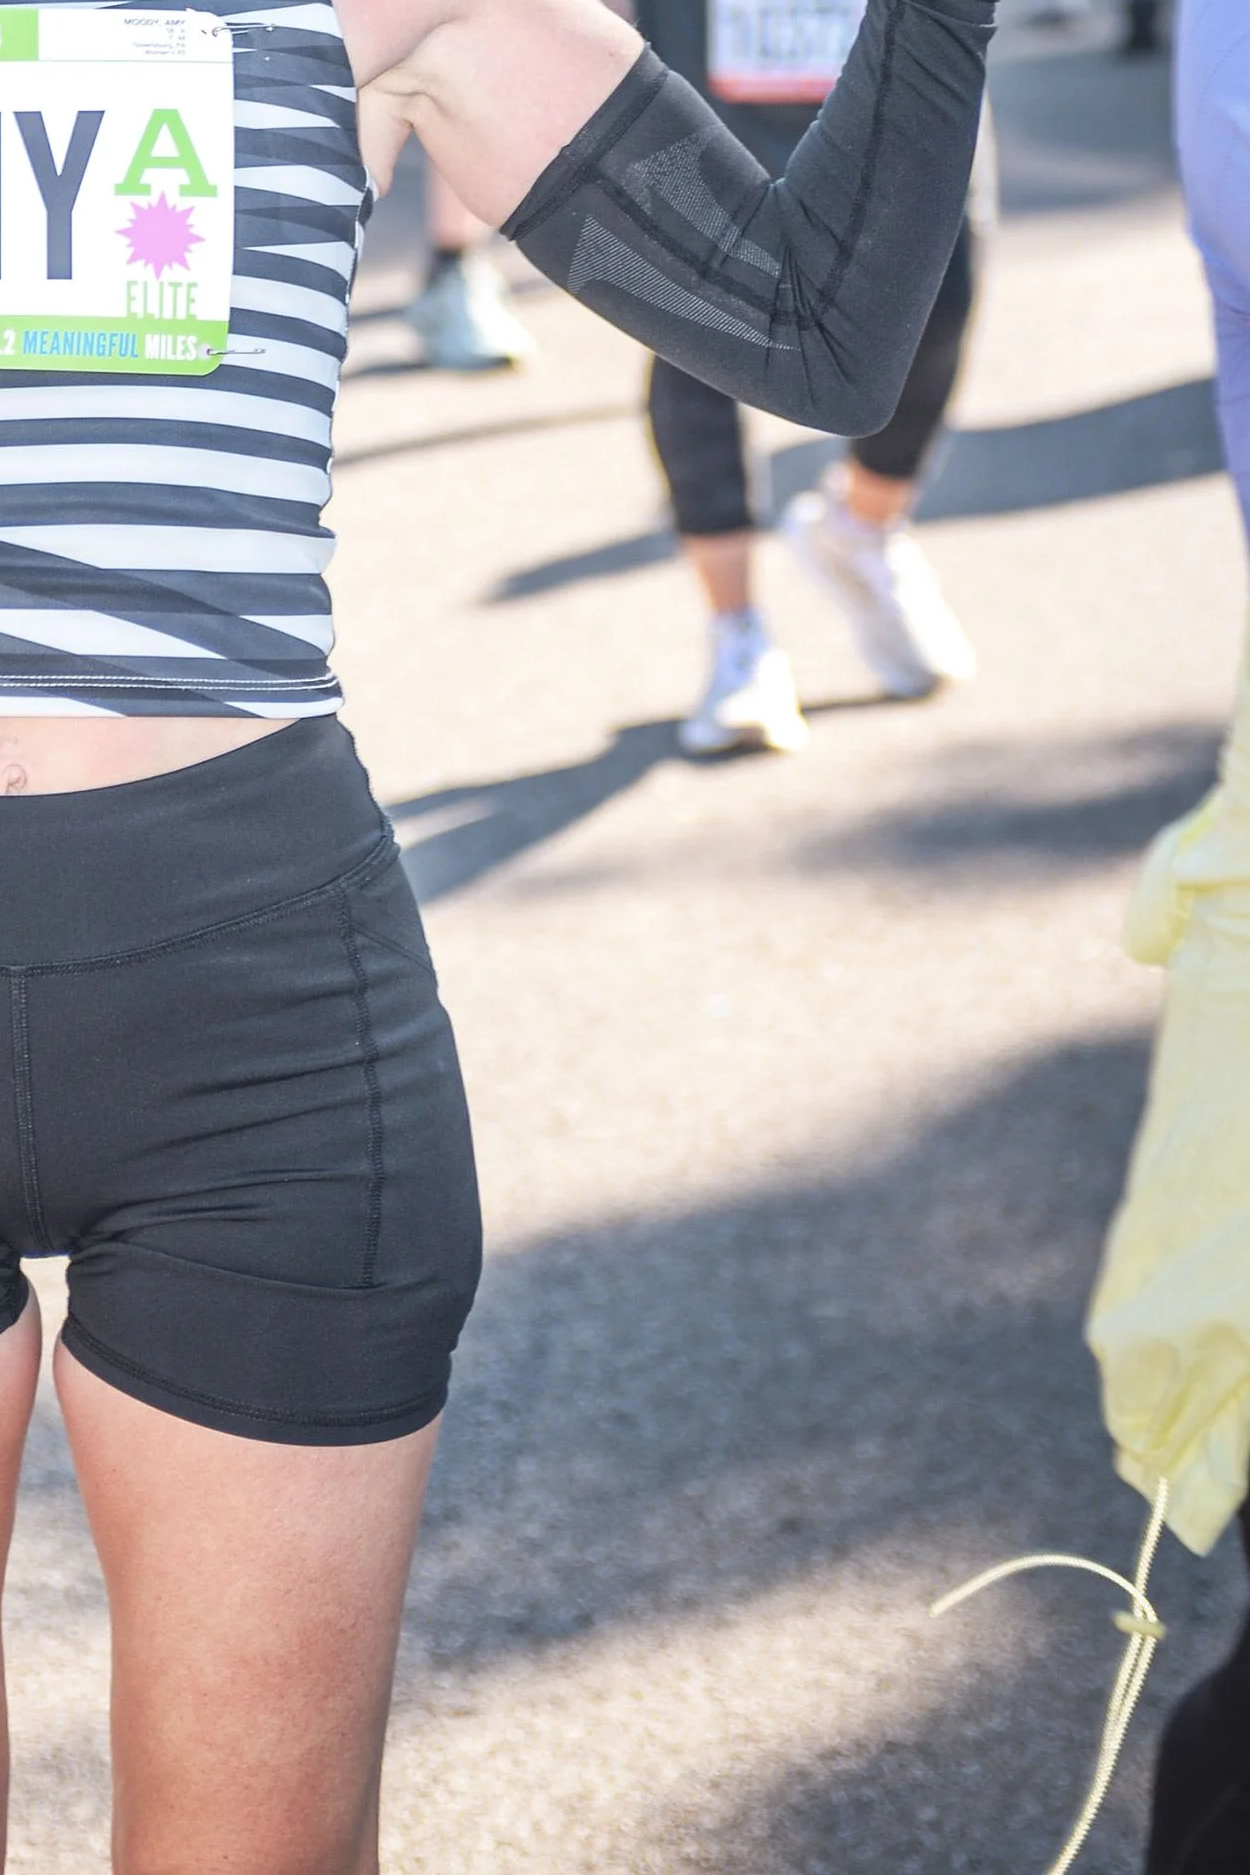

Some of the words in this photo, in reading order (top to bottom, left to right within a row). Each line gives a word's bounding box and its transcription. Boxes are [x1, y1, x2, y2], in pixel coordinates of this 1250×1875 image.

[114, 109, 218, 197] A
[126, 280, 198, 320] ELITE
[23, 330, 138, 359] MEANINGFUL
[145, 334, 198, 361] MILES
